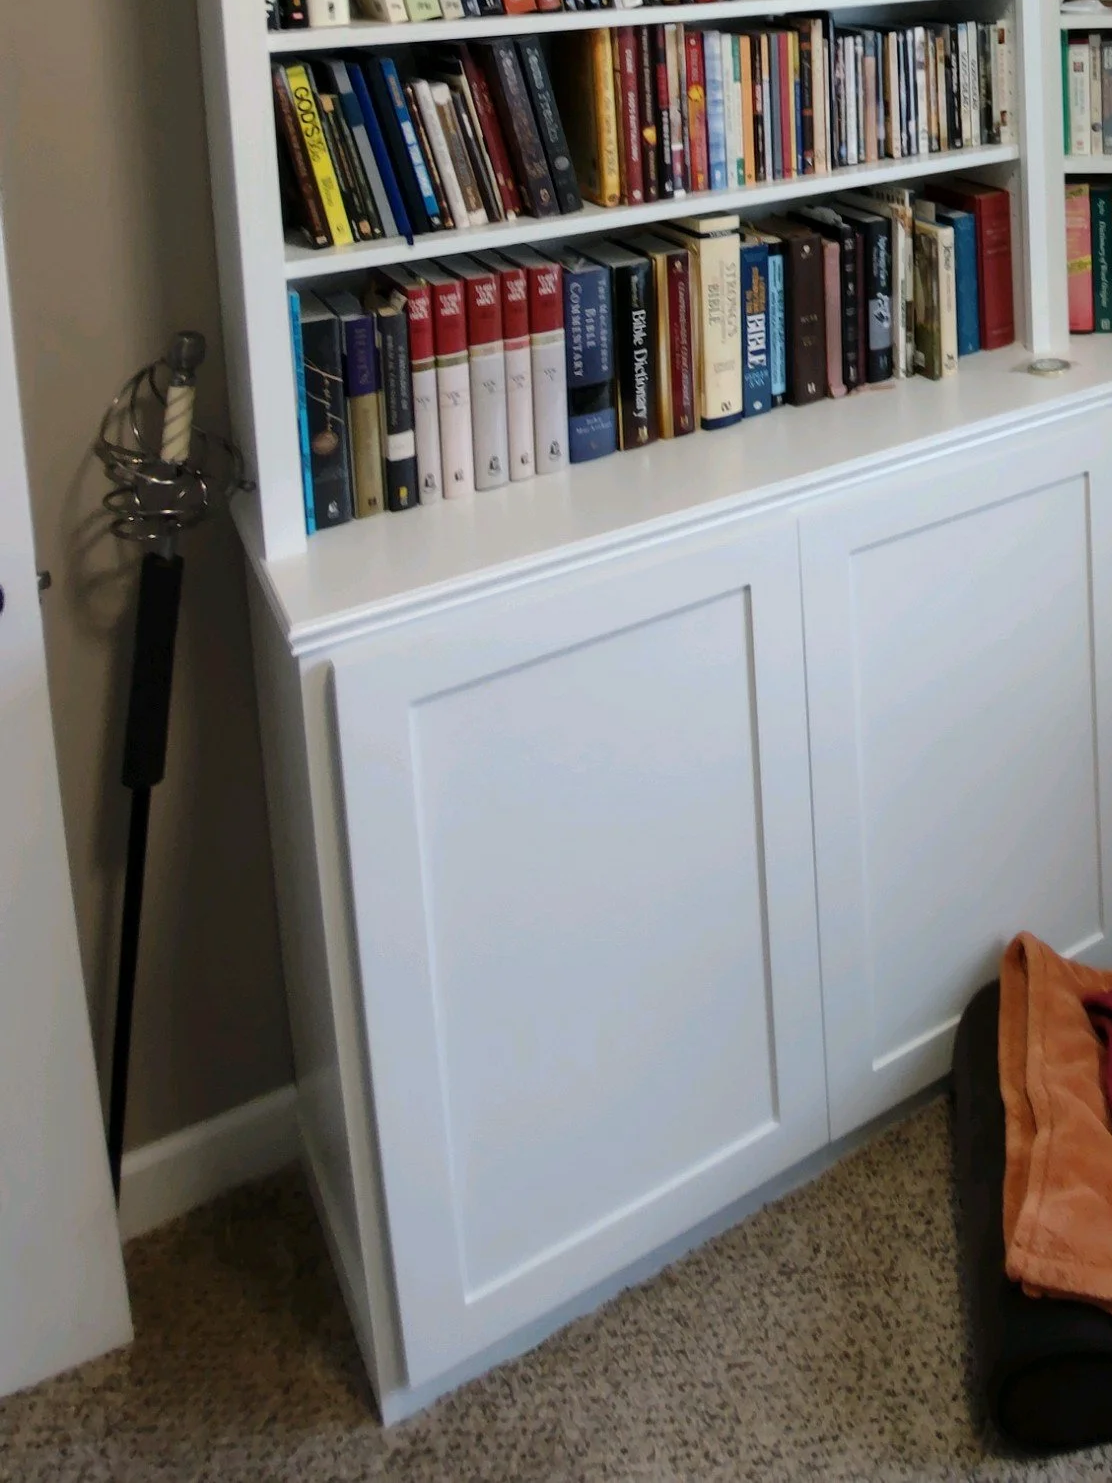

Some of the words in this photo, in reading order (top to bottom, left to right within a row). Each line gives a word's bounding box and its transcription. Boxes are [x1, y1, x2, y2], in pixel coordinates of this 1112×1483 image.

[295, 86, 321, 138] GOD'S
[597, 278, 608, 300] THE
[708, 283, 721, 326] BIBLE
[569, 281, 585, 377] COMMENTARY
[585, 308, 597, 348] BIBLE
[632, 309, 647, 347] Bible
[746, 314, 766, 370] BIBLE
[632, 348, 649, 420] Dictionary
